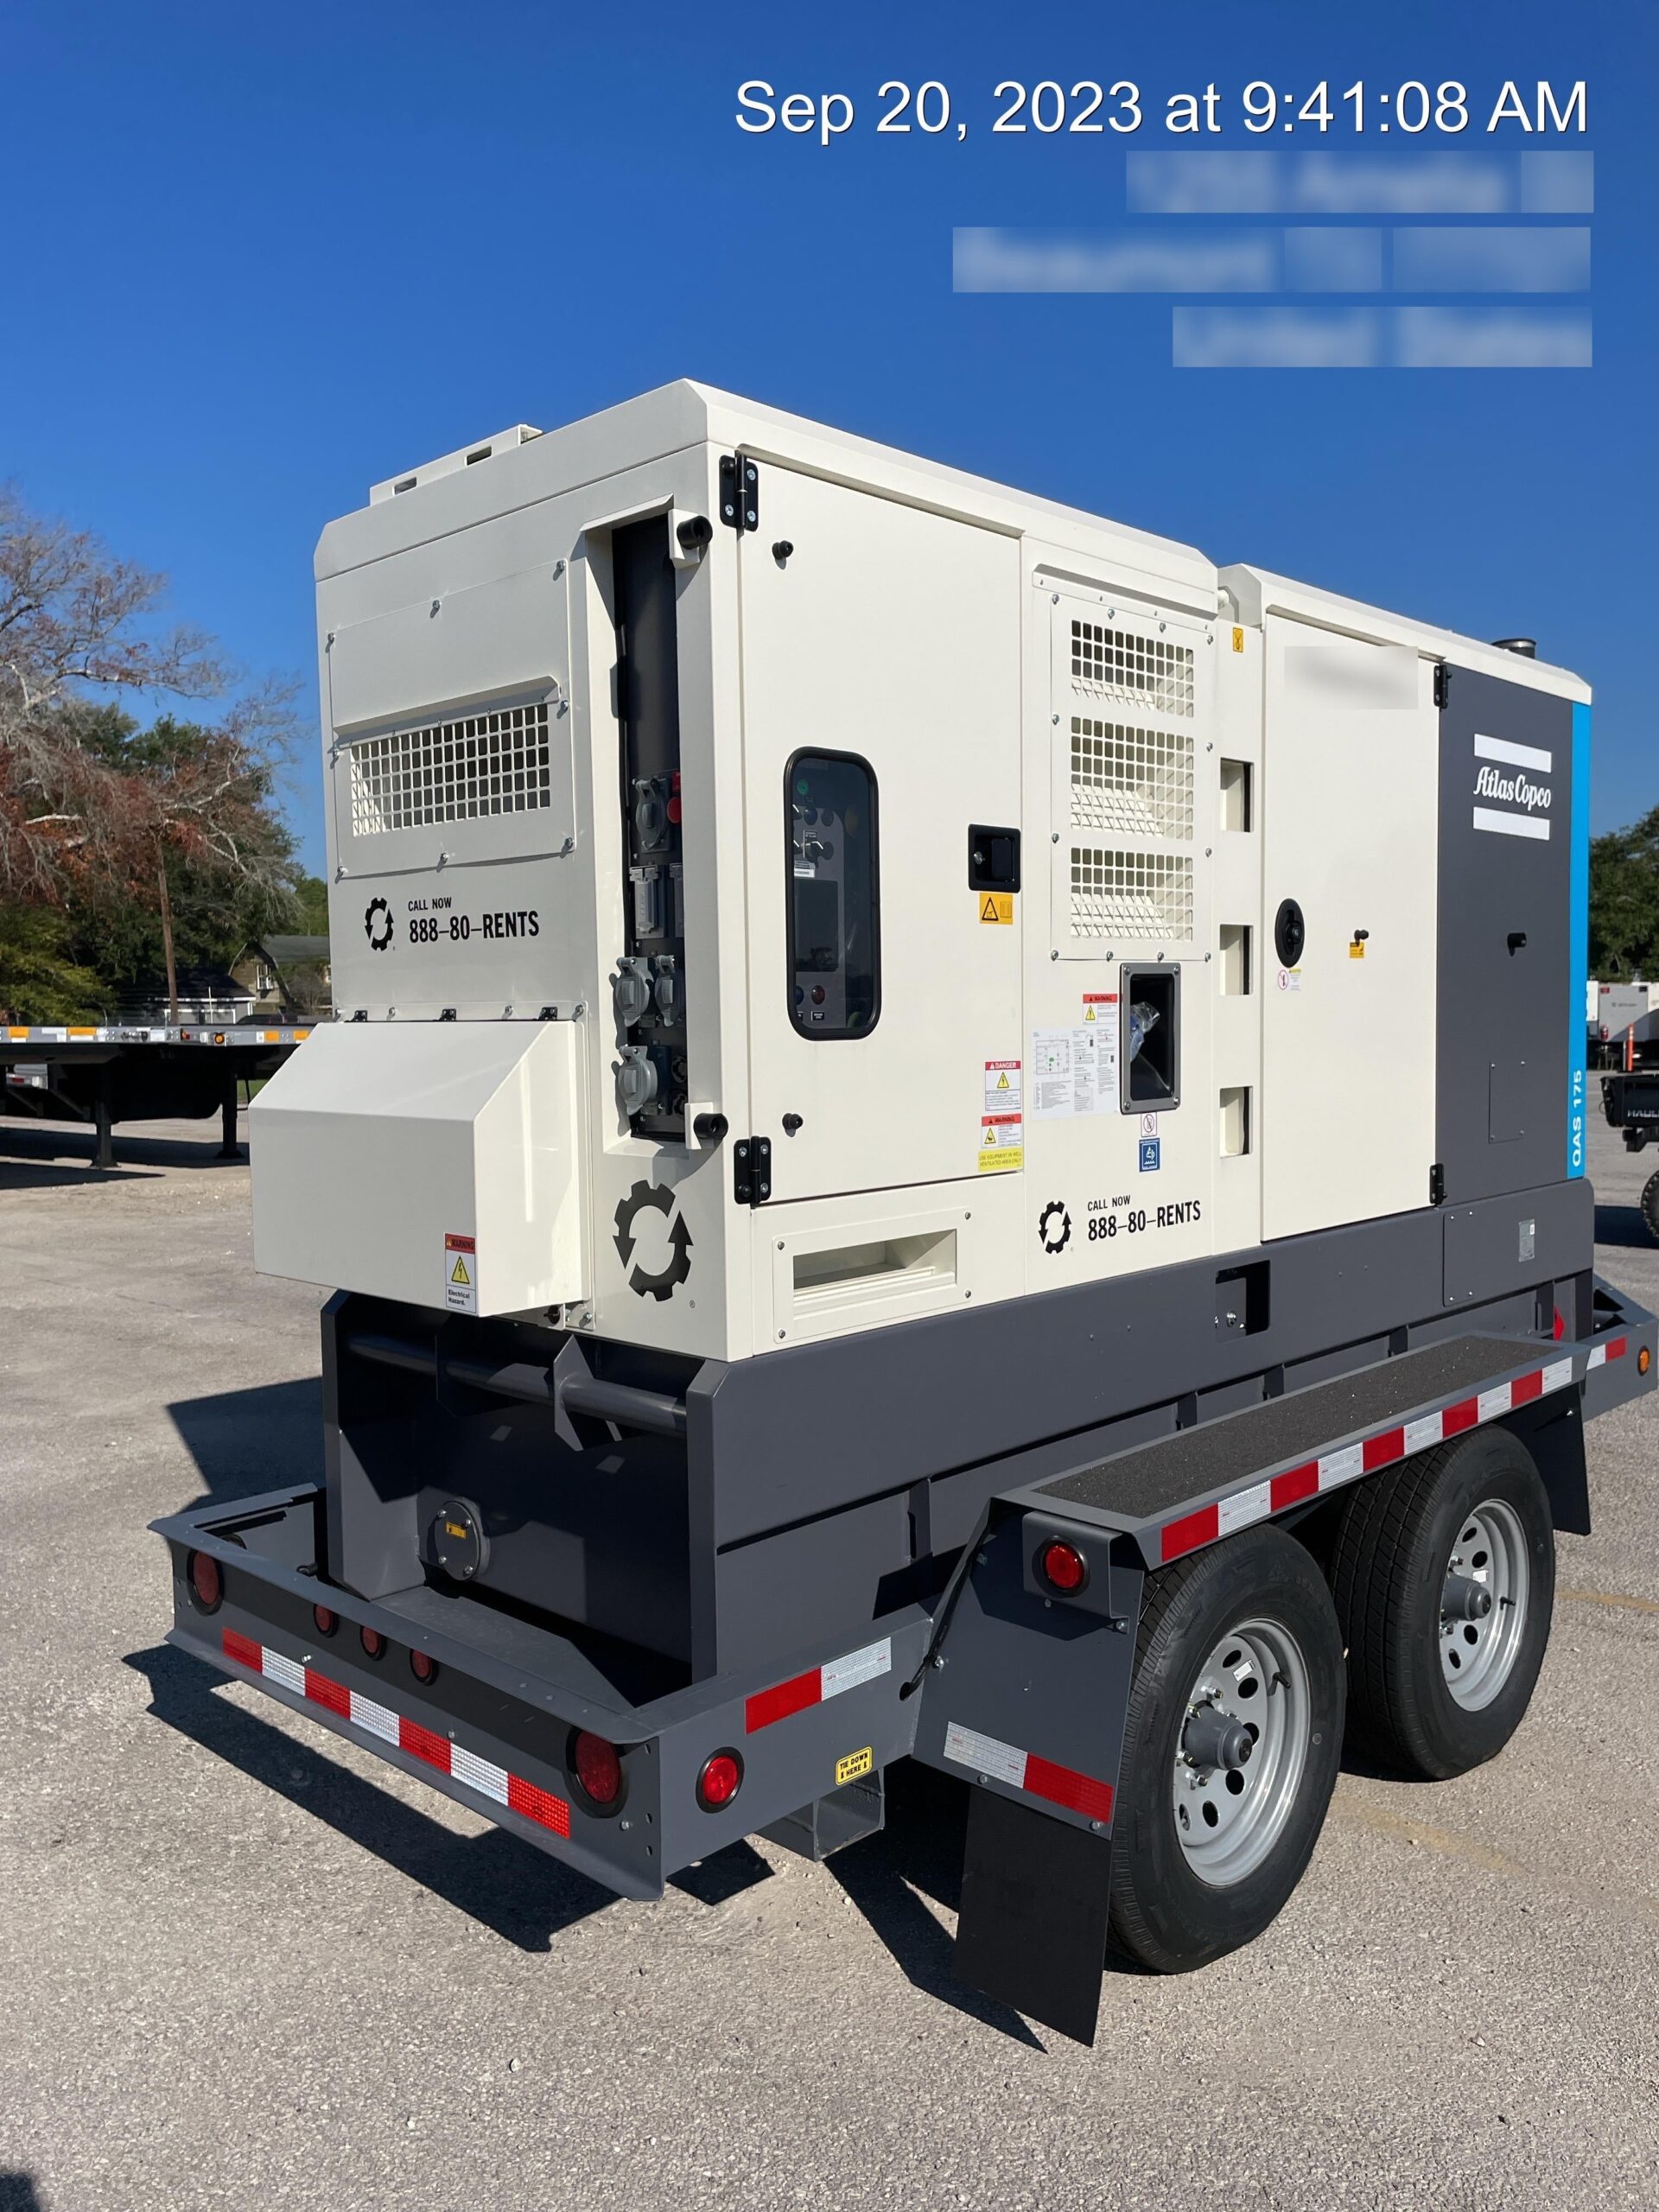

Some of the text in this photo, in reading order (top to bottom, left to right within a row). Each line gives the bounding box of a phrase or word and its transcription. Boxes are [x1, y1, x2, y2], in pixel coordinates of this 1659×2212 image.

[408, 897, 452, 912] CALL NOW
[410, 910, 539, 944] 888-80-RENTS
[1573, 1070, 1582, 1167] QAS 175
[1087, 1195, 1131, 1211] CALL NOW
[1088, 1200, 1201, 1242] 888-80-RENTS
[452, 1238, 474, 1251] WARNING
[448, 1288, 470, 1299] Electrical
[840, 1752, 868, 1770] TIE DOWN
[847, 1764, 861, 1776] HERE
